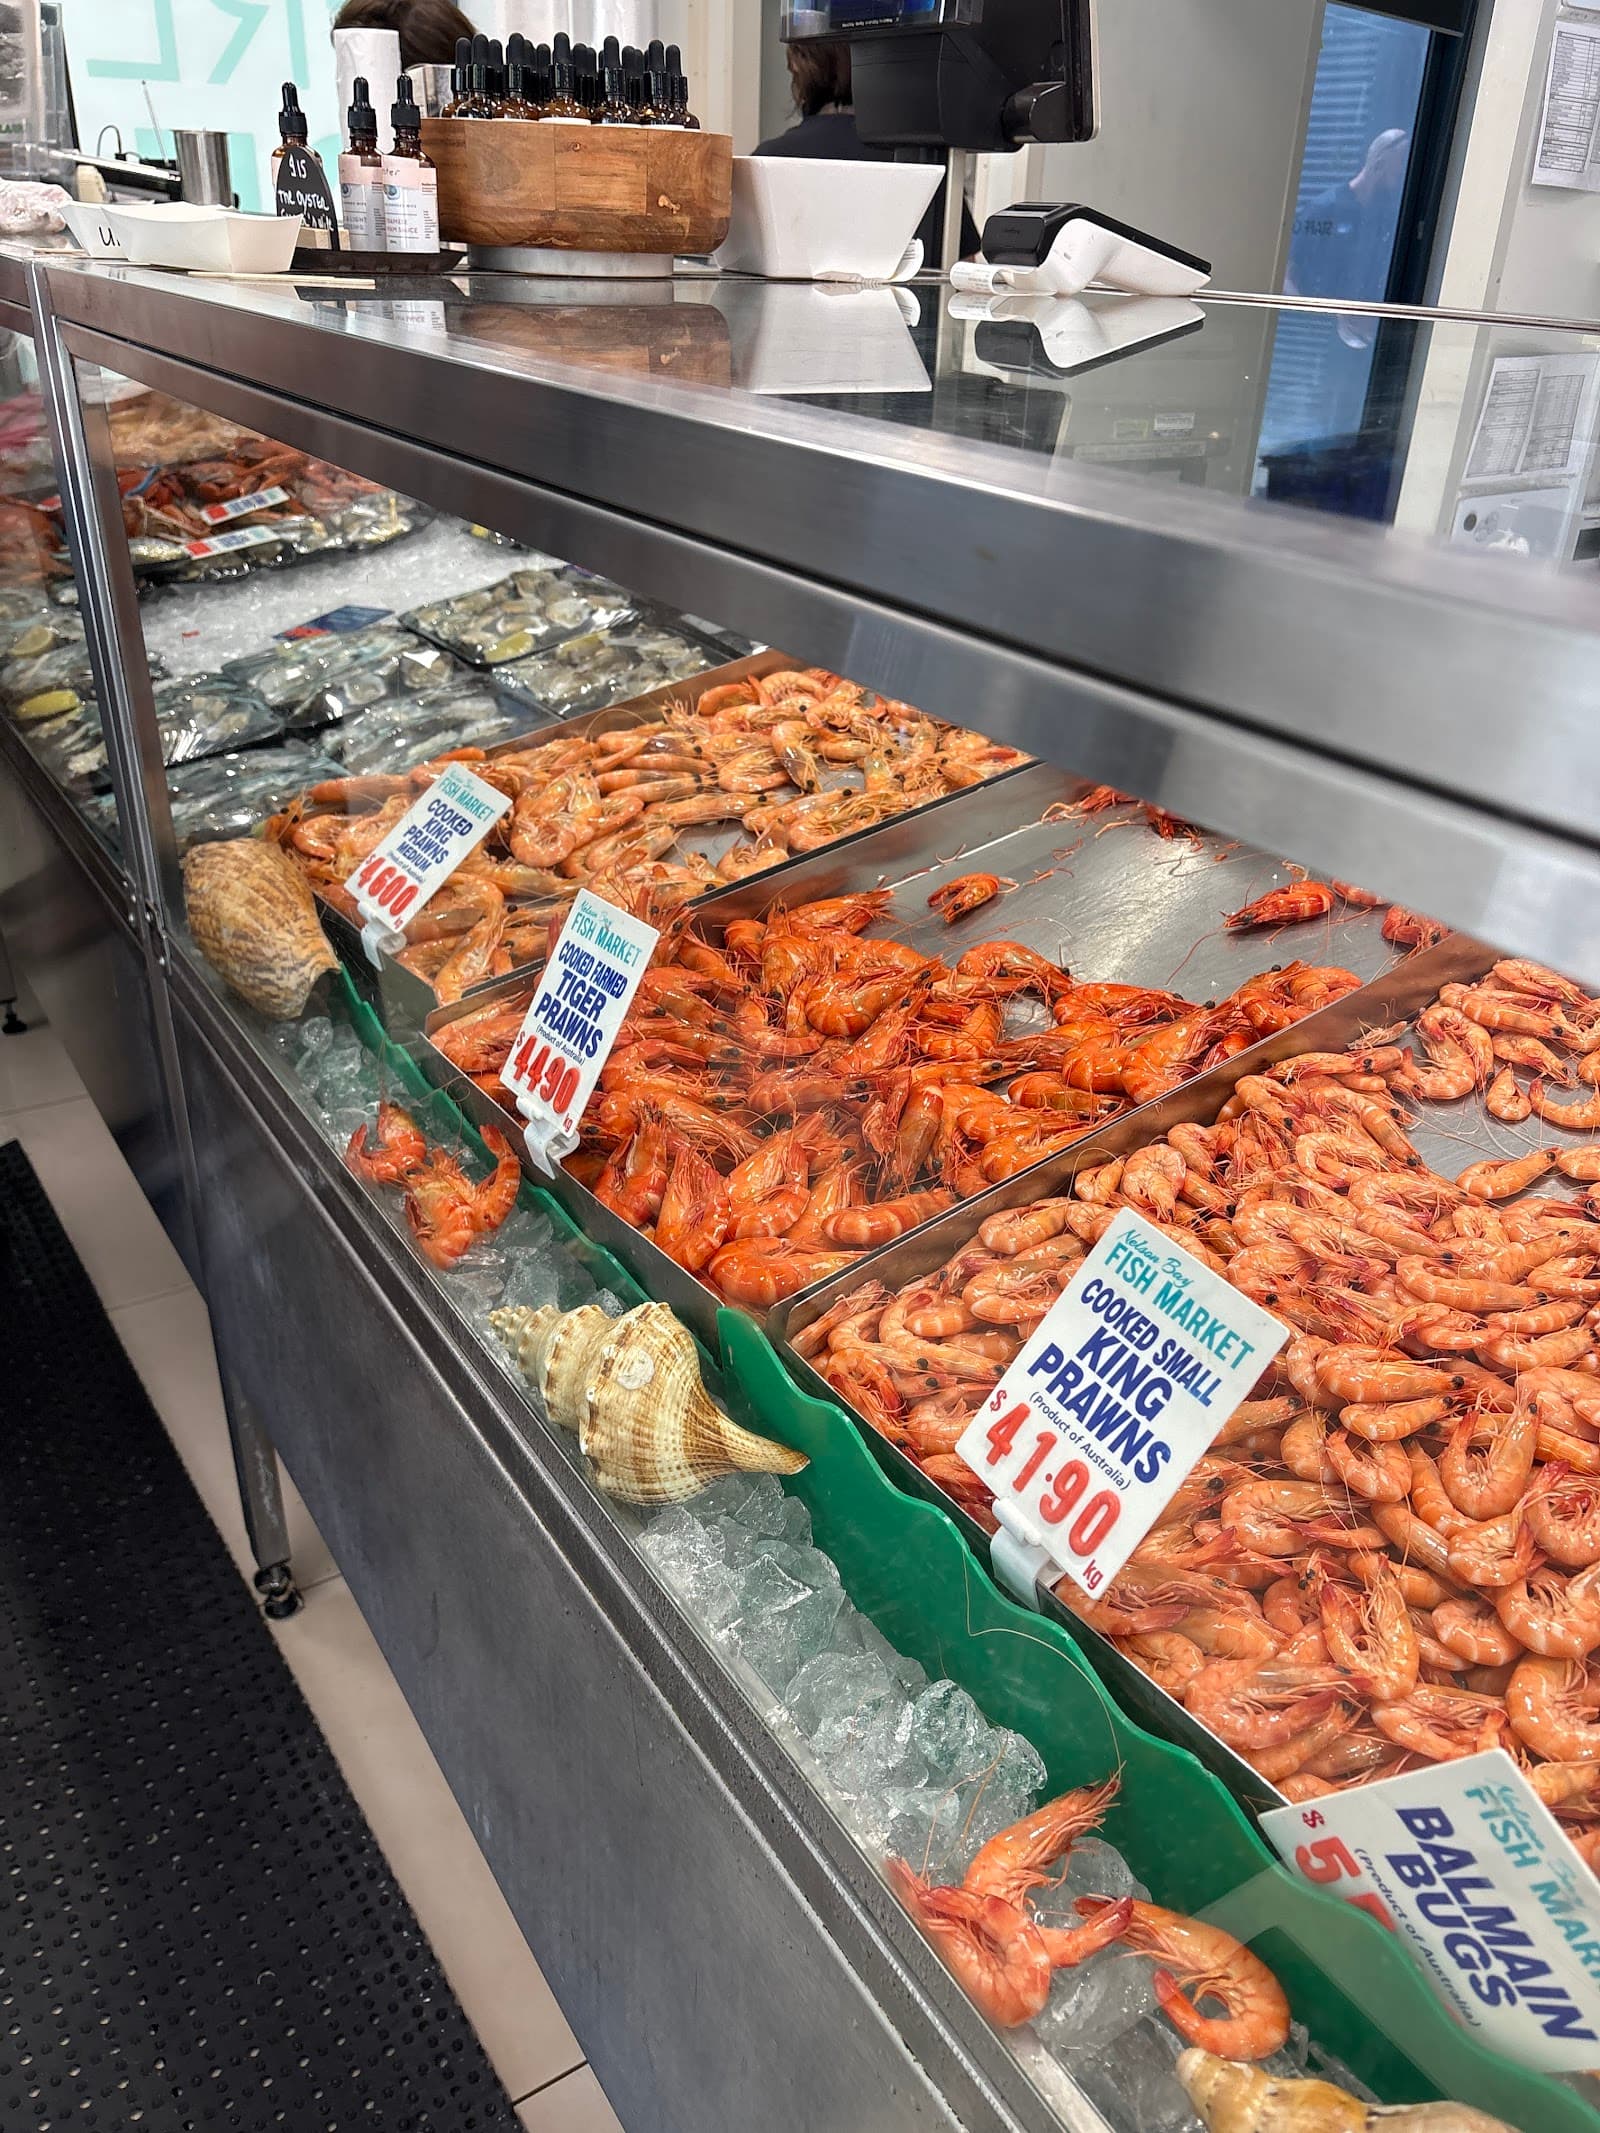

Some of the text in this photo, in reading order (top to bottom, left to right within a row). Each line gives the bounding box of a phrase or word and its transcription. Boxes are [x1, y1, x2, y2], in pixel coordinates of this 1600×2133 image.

[427, 799, 473, 836] COOKED
[439, 777, 461, 798] FISH
[456, 790, 496, 822] MARKET
[396, 841, 432, 872] MEDIUM
[403, 825, 449, 864] PRAWNS
[422, 817, 454, 845] KING
[558, 940, 628, 1000] COOKED FARMED
[571, 912, 642, 968] FISH MARKET
[534, 992, 603, 1059] PRAWNS
[555, 969, 607, 1023] TIGER
[536, 1024, 586, 1066] (Product of Australia)
[562, 1113, 573, 1133] kg
[1117, 1229, 1194, 1289] Nelson Bay
[1104, 1242, 1255, 1371] FISH MARKET
[1080, 1278, 1222, 1408] COOKED SMALL
[1076, 1327, 1173, 1422] KING
[1027, 1343, 1172, 1484] PRAWNS
[1028, 1391, 1131, 1491] (Product of Australia)
[1082, 1559, 1103, 1590] kg
[1464, 1787, 1600, 1985] FISH MAR
[1354, 1848, 1482, 2027] (Product of Australia)
[1385, 1853, 1517, 2008] BUGS
[1396, 1807, 1599, 2042] BALMAIN
